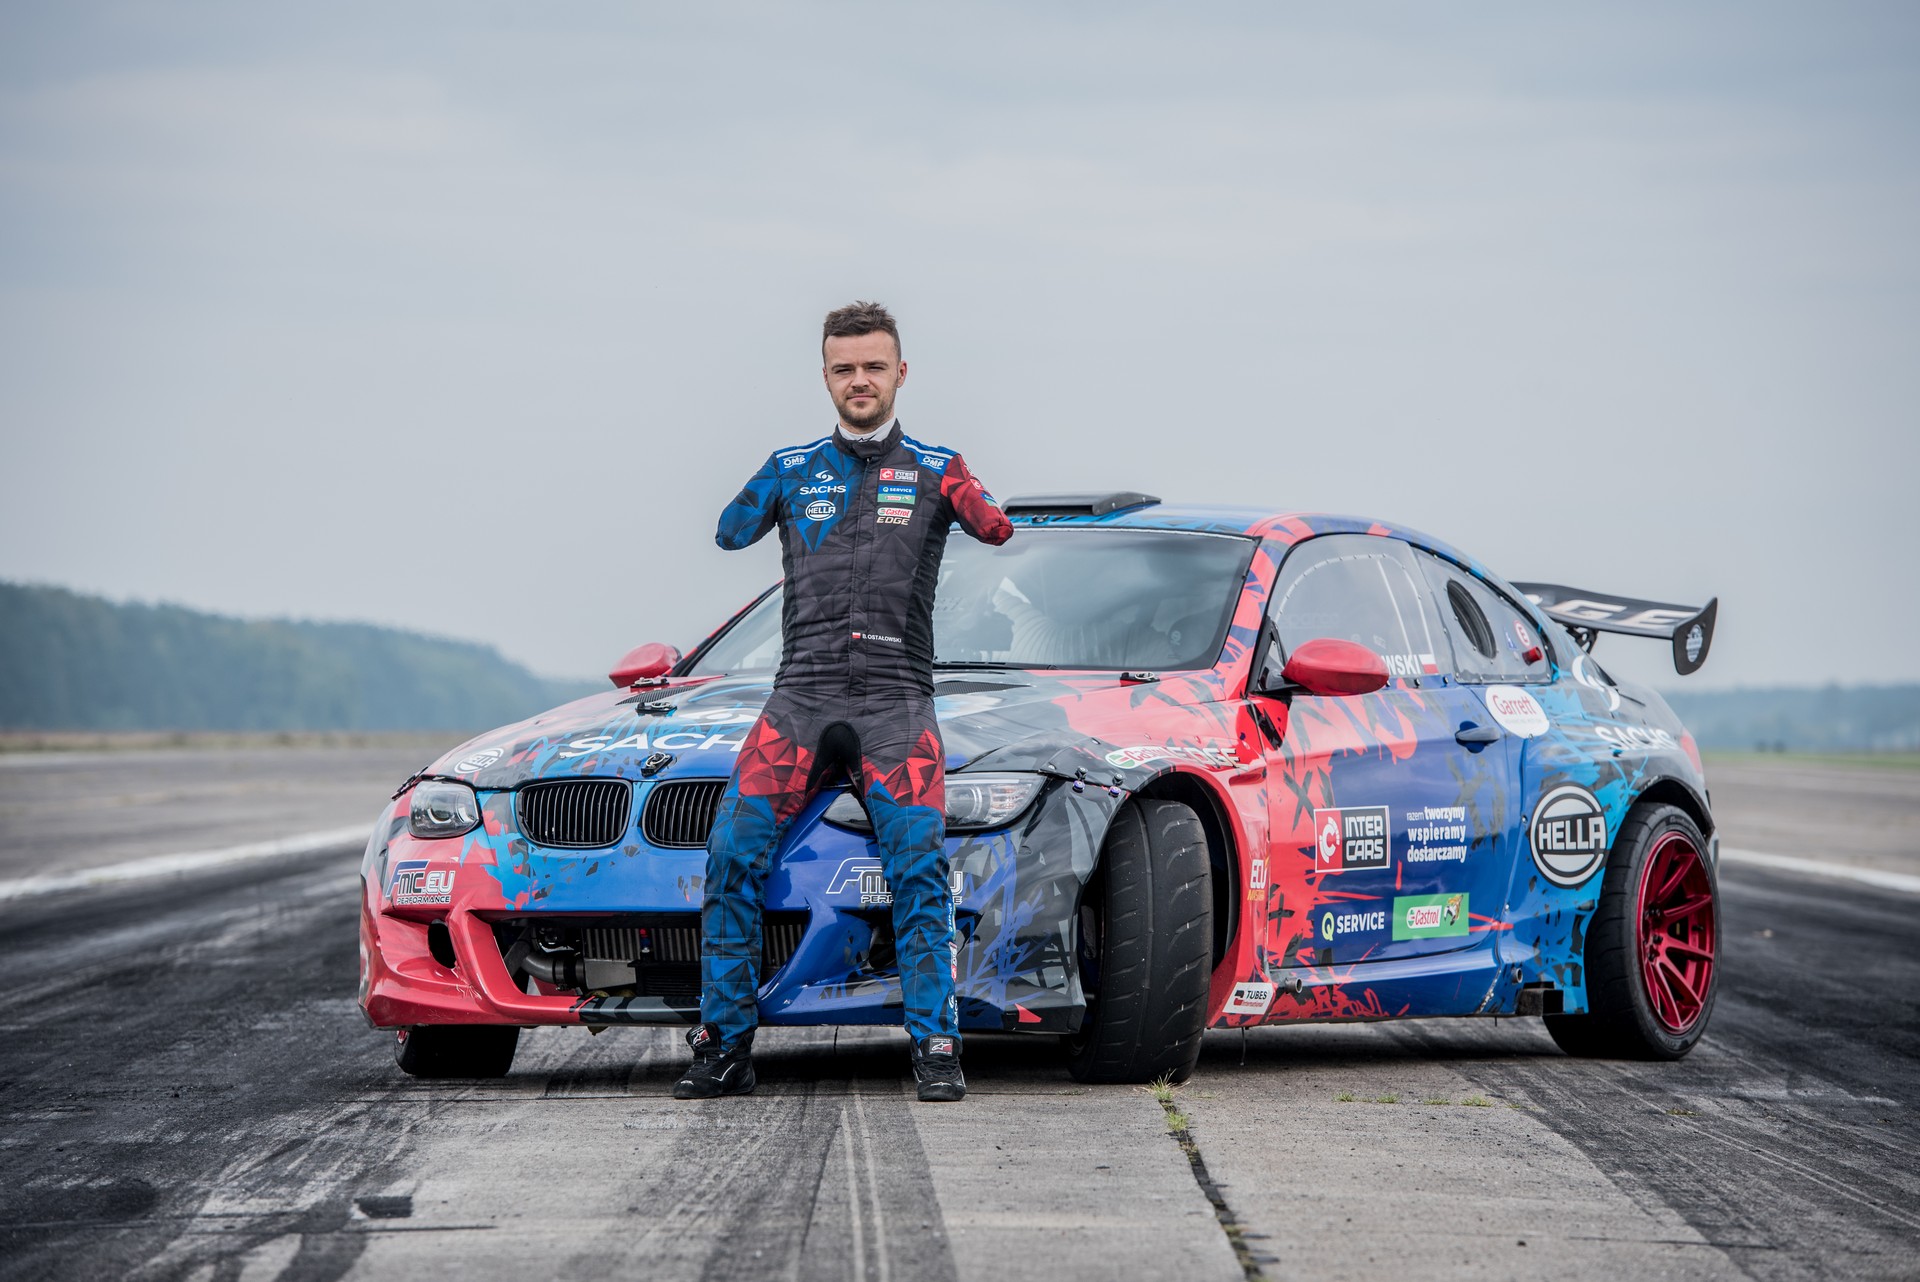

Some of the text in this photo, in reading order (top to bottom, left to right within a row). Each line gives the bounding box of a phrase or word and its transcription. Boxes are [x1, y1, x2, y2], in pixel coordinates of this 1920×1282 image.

[783, 456, 806, 467] OMP
[922, 457, 944, 467] OMP
[800, 485, 847, 495] SACHS
[808, 506, 836, 514] HELLA
[885, 508, 910, 517] Castrol
[876, 516, 910, 526] EDGE
[1523, 594, 1698, 627] GE
[1381, 655, 1421, 675] WSKI
[1492, 695, 1537, 715] Garrett
[560, 733, 748, 758] SACH
[1595, 726, 1680, 750] SACHS
[1166, 747, 1250, 771] EDGE
[1406, 806, 1466, 822] razem tworzymy
[1345, 815, 1384, 838] INTER
[1408, 822, 1466, 845] wspieramy
[1539, 816, 1606, 850] HELLA
[1346, 838, 1384, 861] CARS
[1407, 845, 1467, 863] dostarczamy
[397, 895, 451, 904] PERFORMANCE
[1336, 912, 1385, 934] SERVICE
[1415, 908, 1439, 925] Castrol
[1246, 990, 1268, 1000] TUBES
